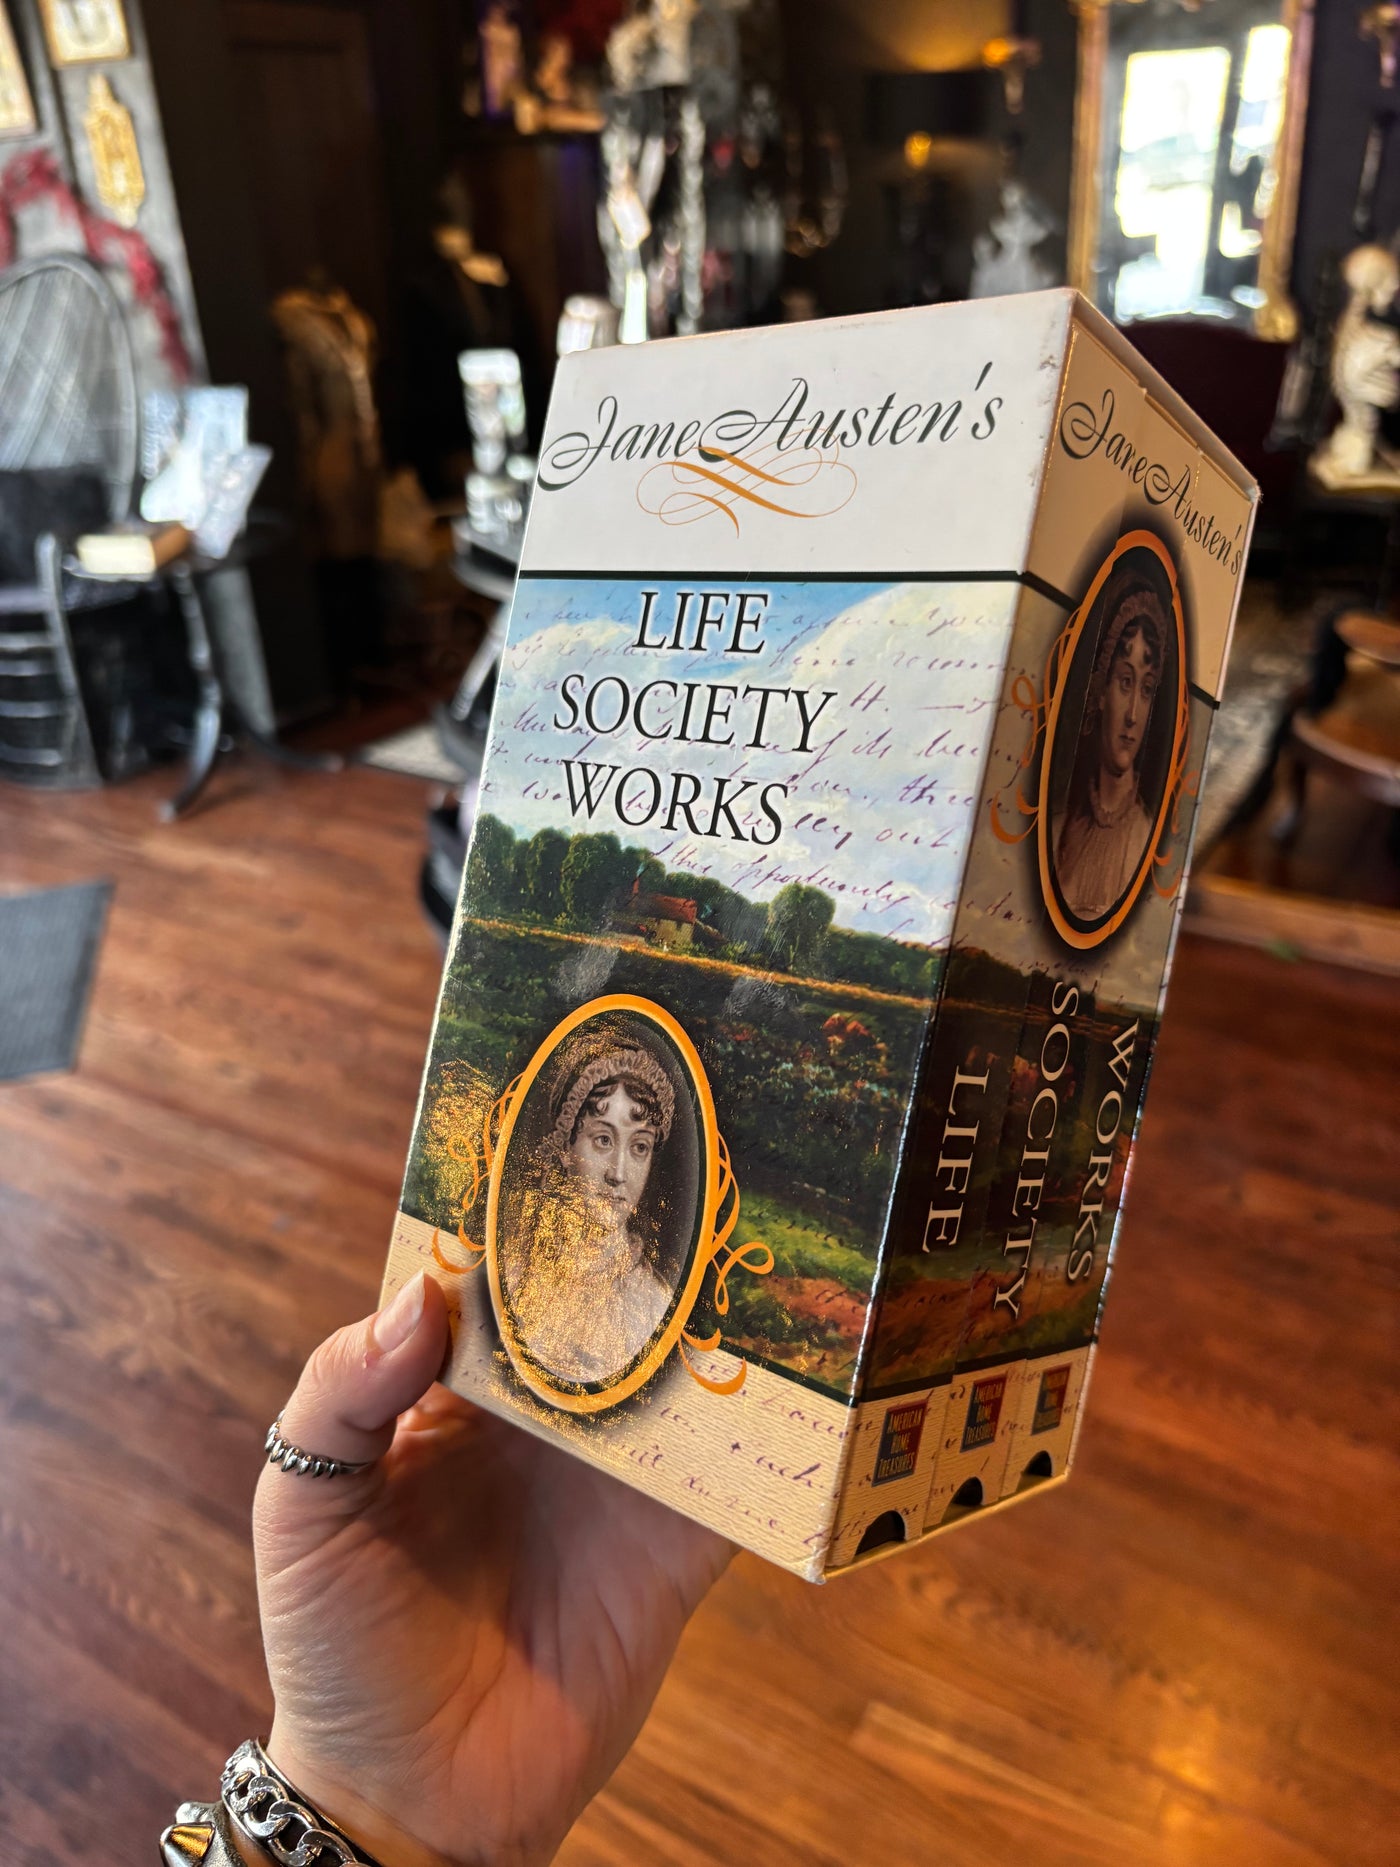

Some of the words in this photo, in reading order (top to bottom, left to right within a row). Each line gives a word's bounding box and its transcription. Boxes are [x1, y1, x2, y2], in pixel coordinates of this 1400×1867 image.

[537, 395, 701, 492] Jane
[697, 361, 1004, 463] Austen's
[1059, 388, 1148, 484] Jane
[1143, 463, 1243, 576] Austen's
[632, 591, 769, 654] LIFE
[553, 673, 838, 754] SOCIETY
[560, 758, 789, 846] WORKS
[922, 1064, 991, 1254] LIFE
[992, 981, 1080, 1320] SOCIETY
[1066, 1016, 1140, 1282] WORKS
[877, 1451, 916, 1479] TREASURES
[886, 1407, 924, 1435] AMERICAN
